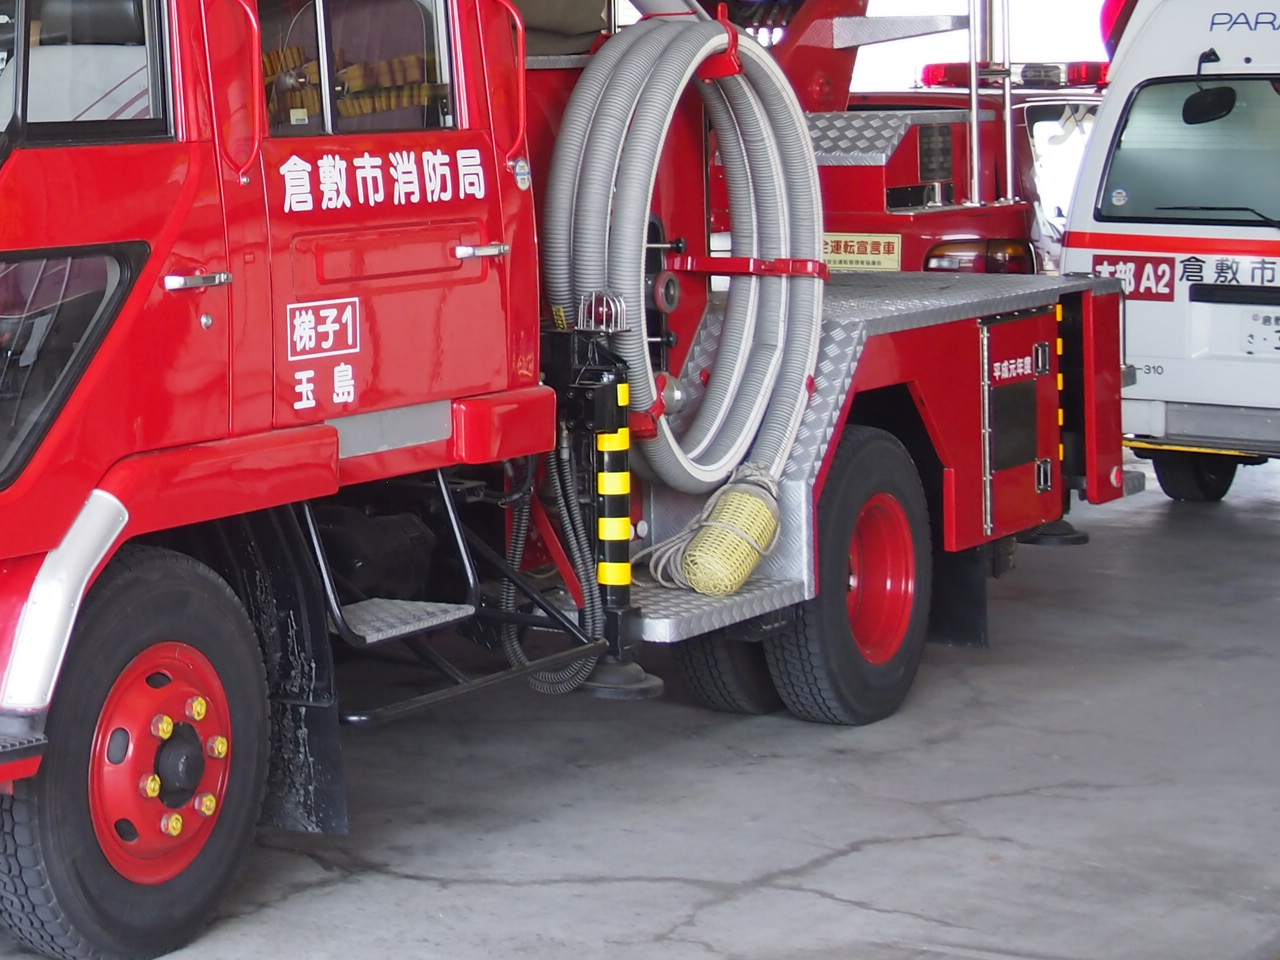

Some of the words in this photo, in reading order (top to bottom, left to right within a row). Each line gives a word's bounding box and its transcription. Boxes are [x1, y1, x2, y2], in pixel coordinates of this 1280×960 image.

[1209, 12, 1280, 31] PAR
[279, 148, 486, 213] 倉敷市消防局
[293, 304, 353, 352] 梯子1
